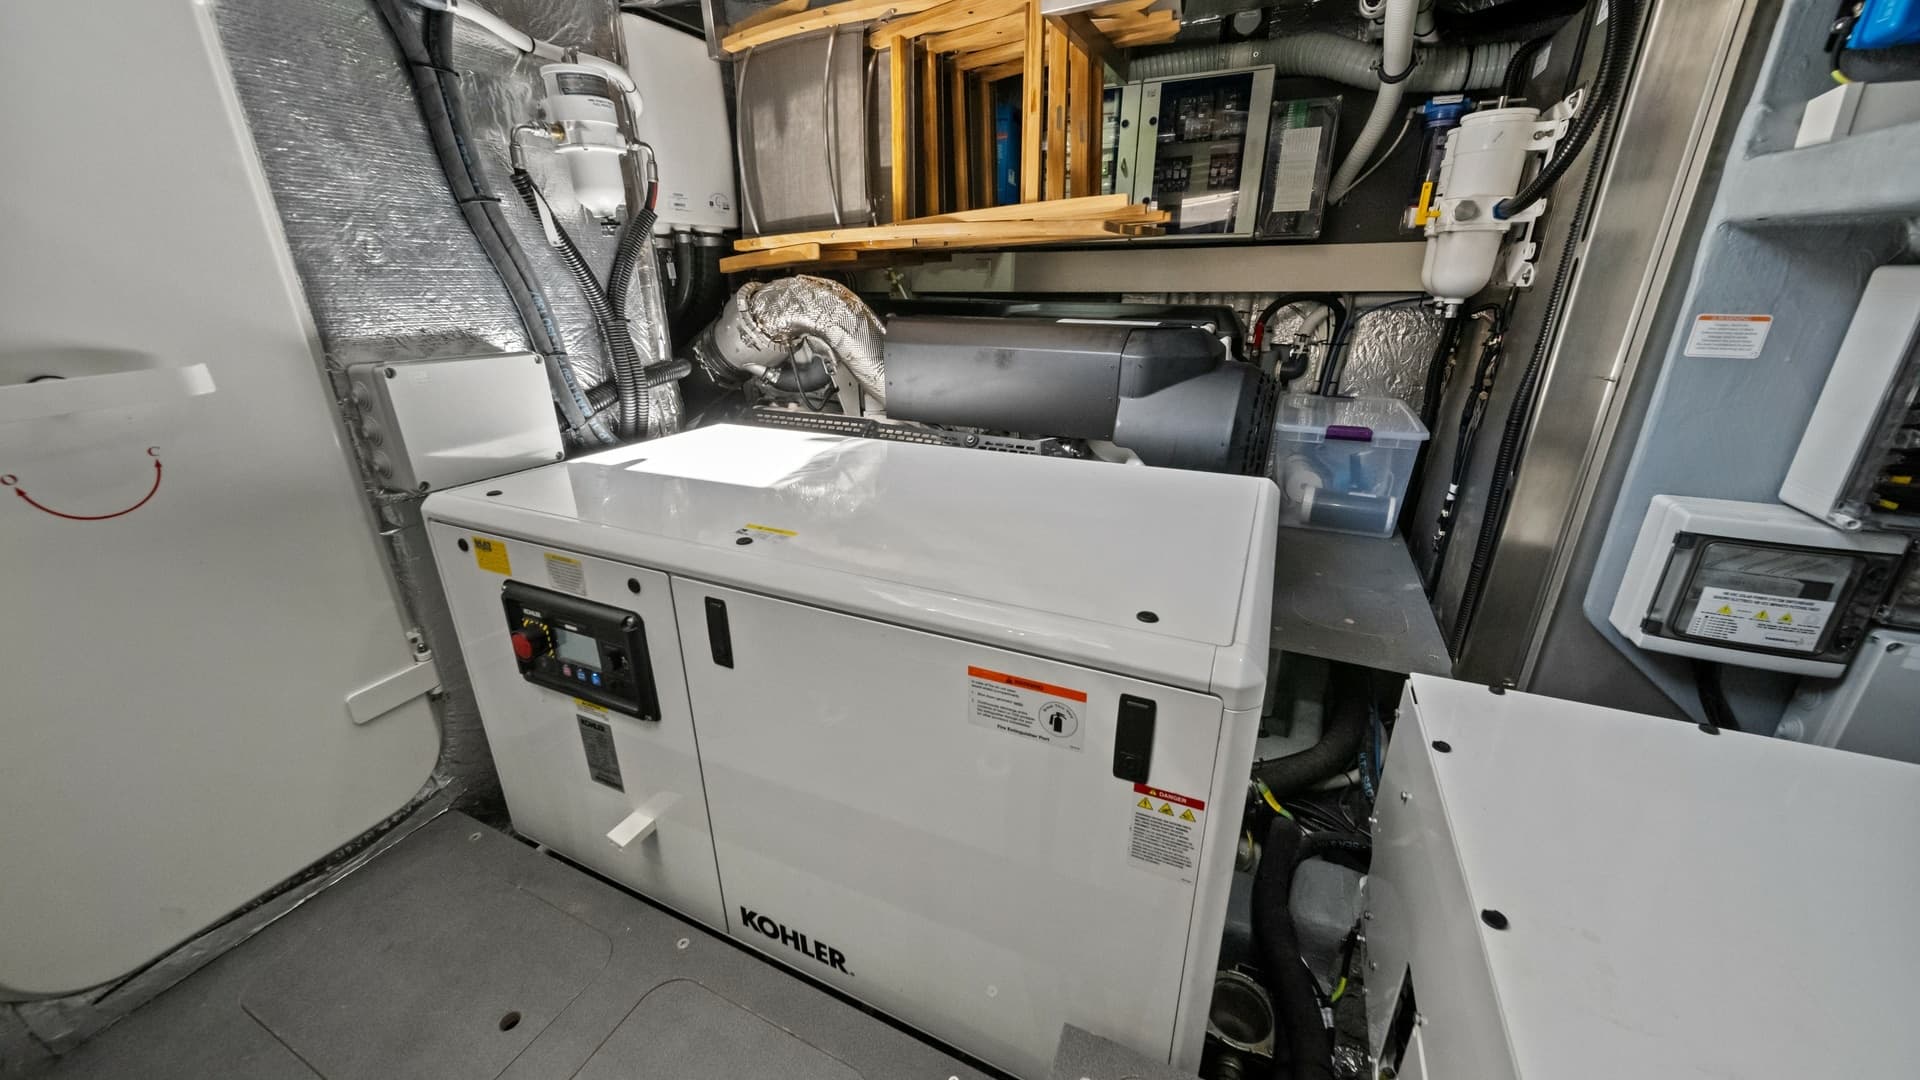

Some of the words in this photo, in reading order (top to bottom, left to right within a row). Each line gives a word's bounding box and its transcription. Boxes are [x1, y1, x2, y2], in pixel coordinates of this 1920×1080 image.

[147, 446, 161, 457] C
[1158, 791, 1188, 804] DANGER
[740, 906, 849, 976] KOHLER
